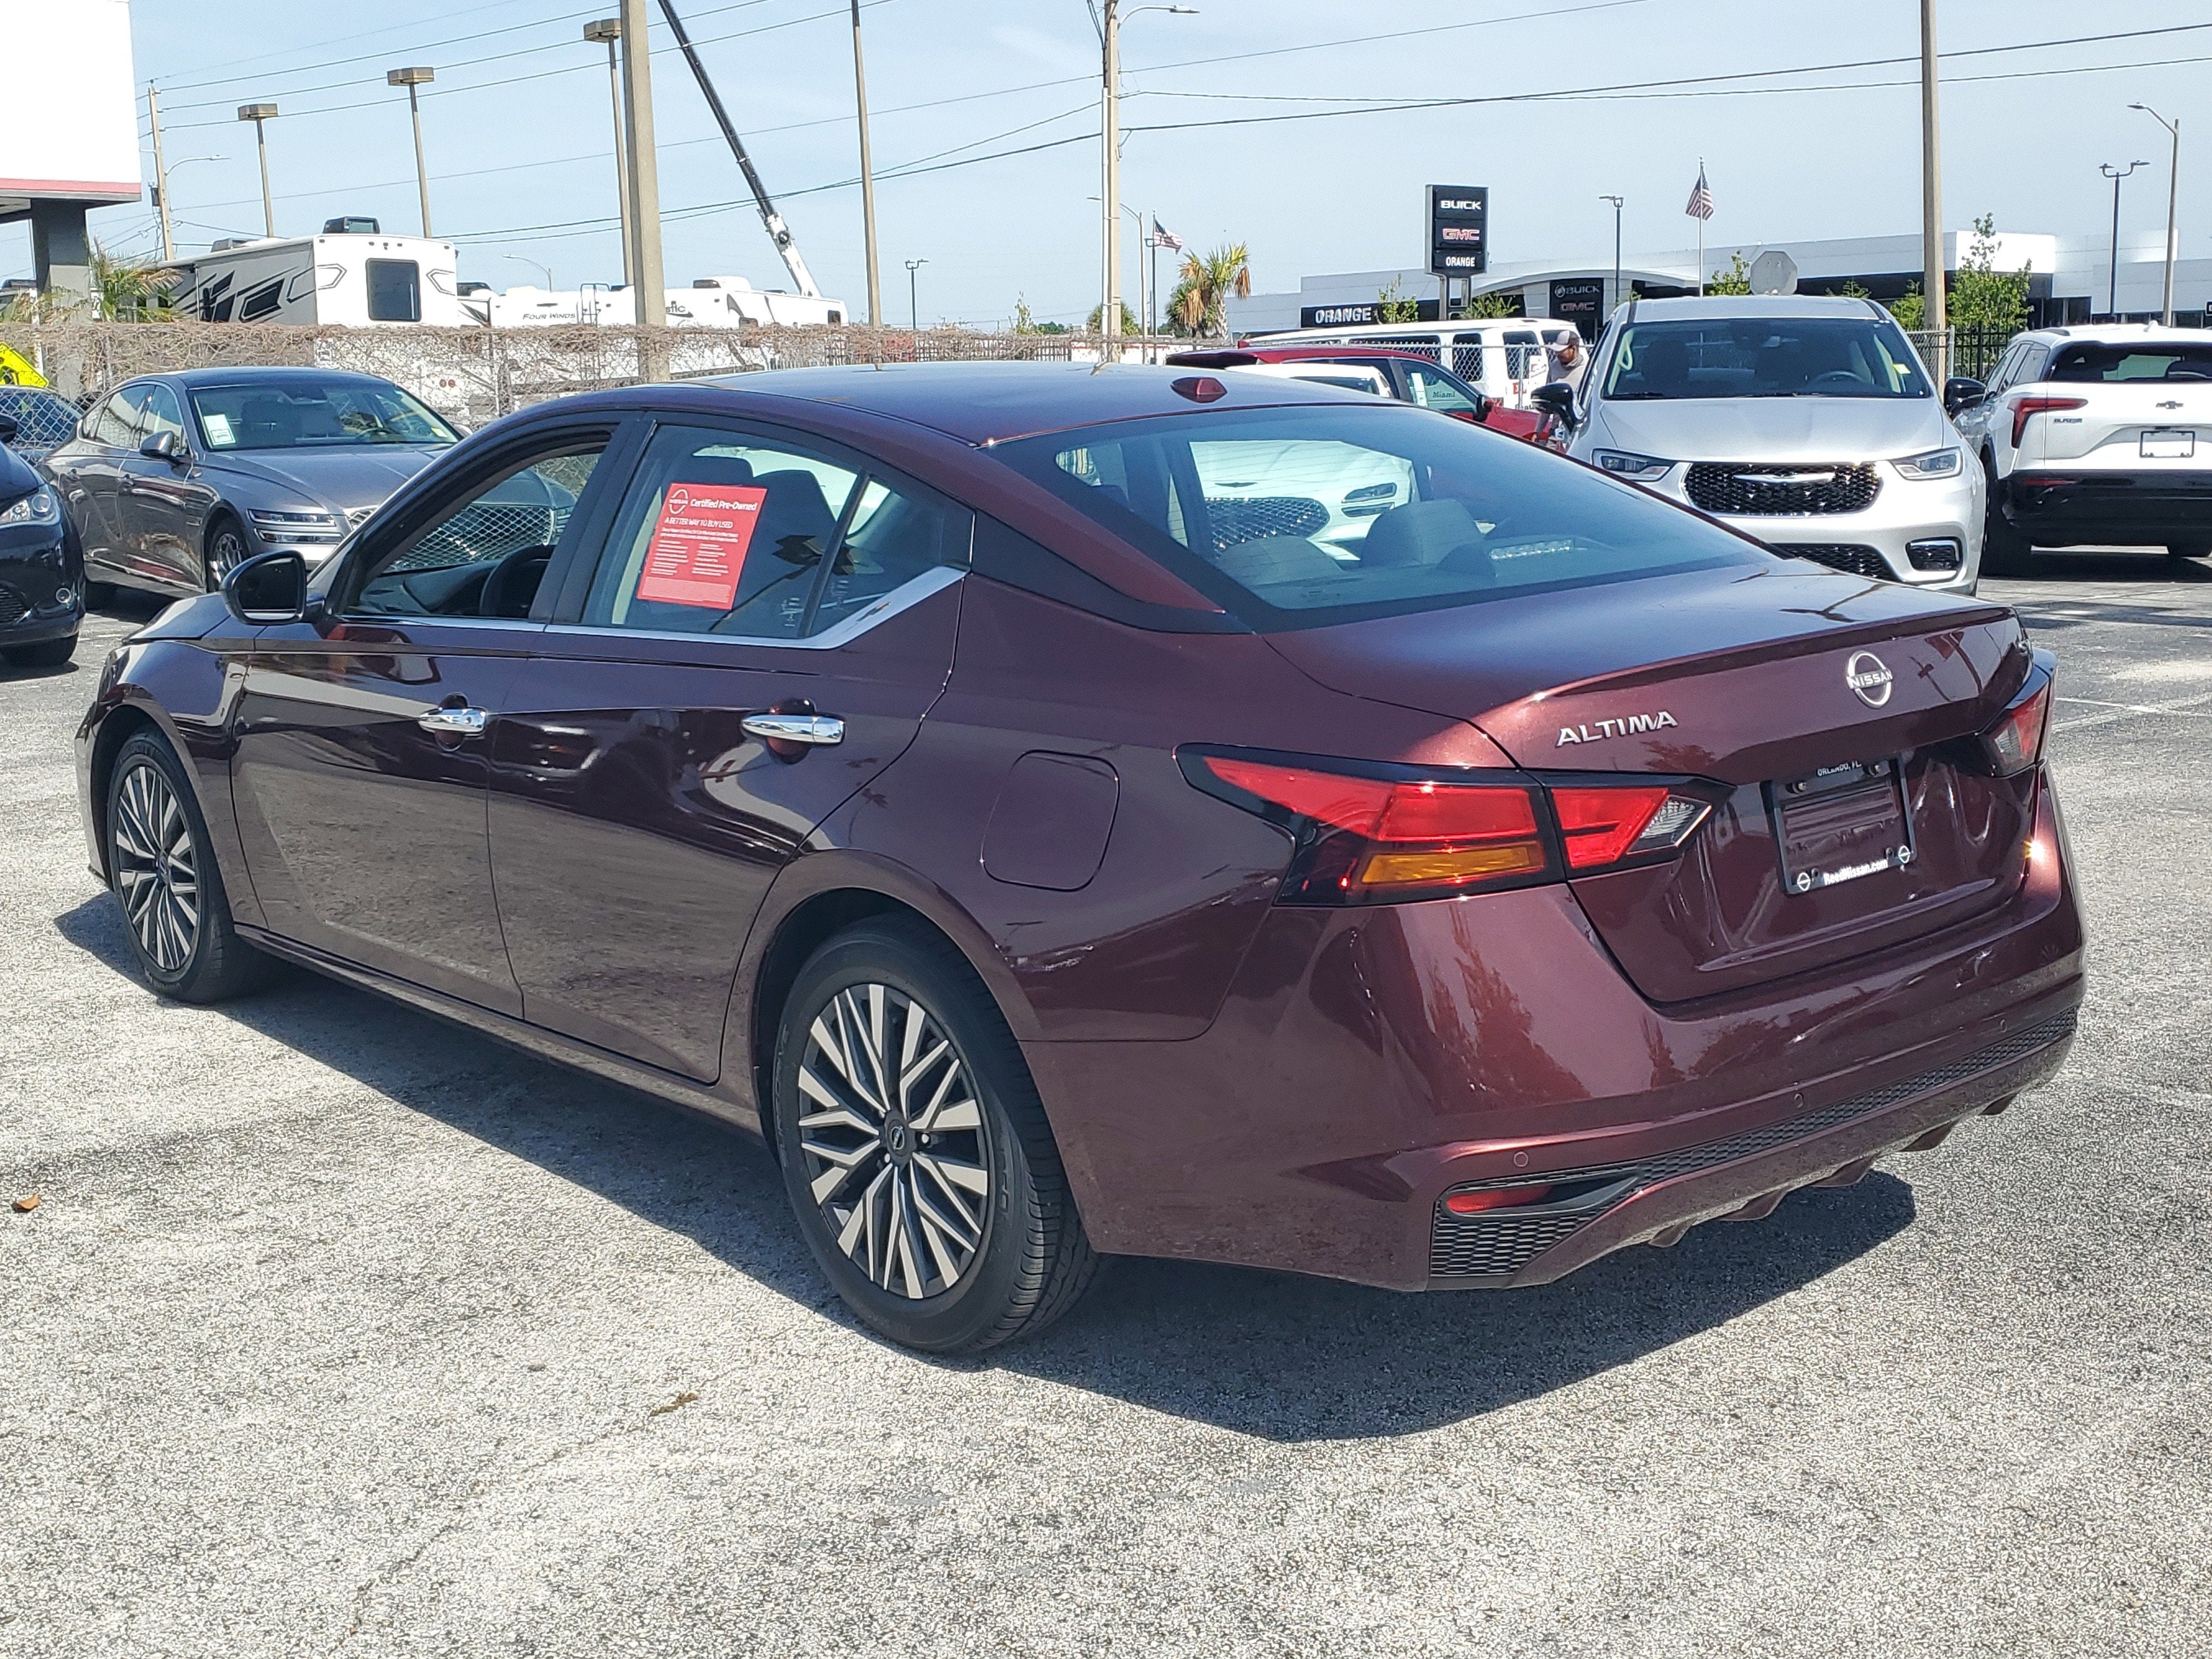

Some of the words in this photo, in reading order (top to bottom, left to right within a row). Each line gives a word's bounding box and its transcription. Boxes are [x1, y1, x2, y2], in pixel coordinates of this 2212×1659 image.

[1440, 200, 1481, 210] BUICK
[1442, 228, 1480, 240] GMC
[1446, 256, 1475, 267] ORANGE
[1566, 286, 1600, 294] BUICK
[1561, 302, 1595, 312] GMC
[1315, 307, 1372, 324] ORANGE
[690, 499, 719, 509] Certified
[718, 500, 758, 511] Pre-Owned
[669, 517, 689, 526] BETTER
[708, 520, 719, 528] BUY
[1846, 668, 1893, 689] NISSAN
[1556, 710, 1678, 746] ALTIMA
[1823, 859, 1888, 885] ReedNissan.com
